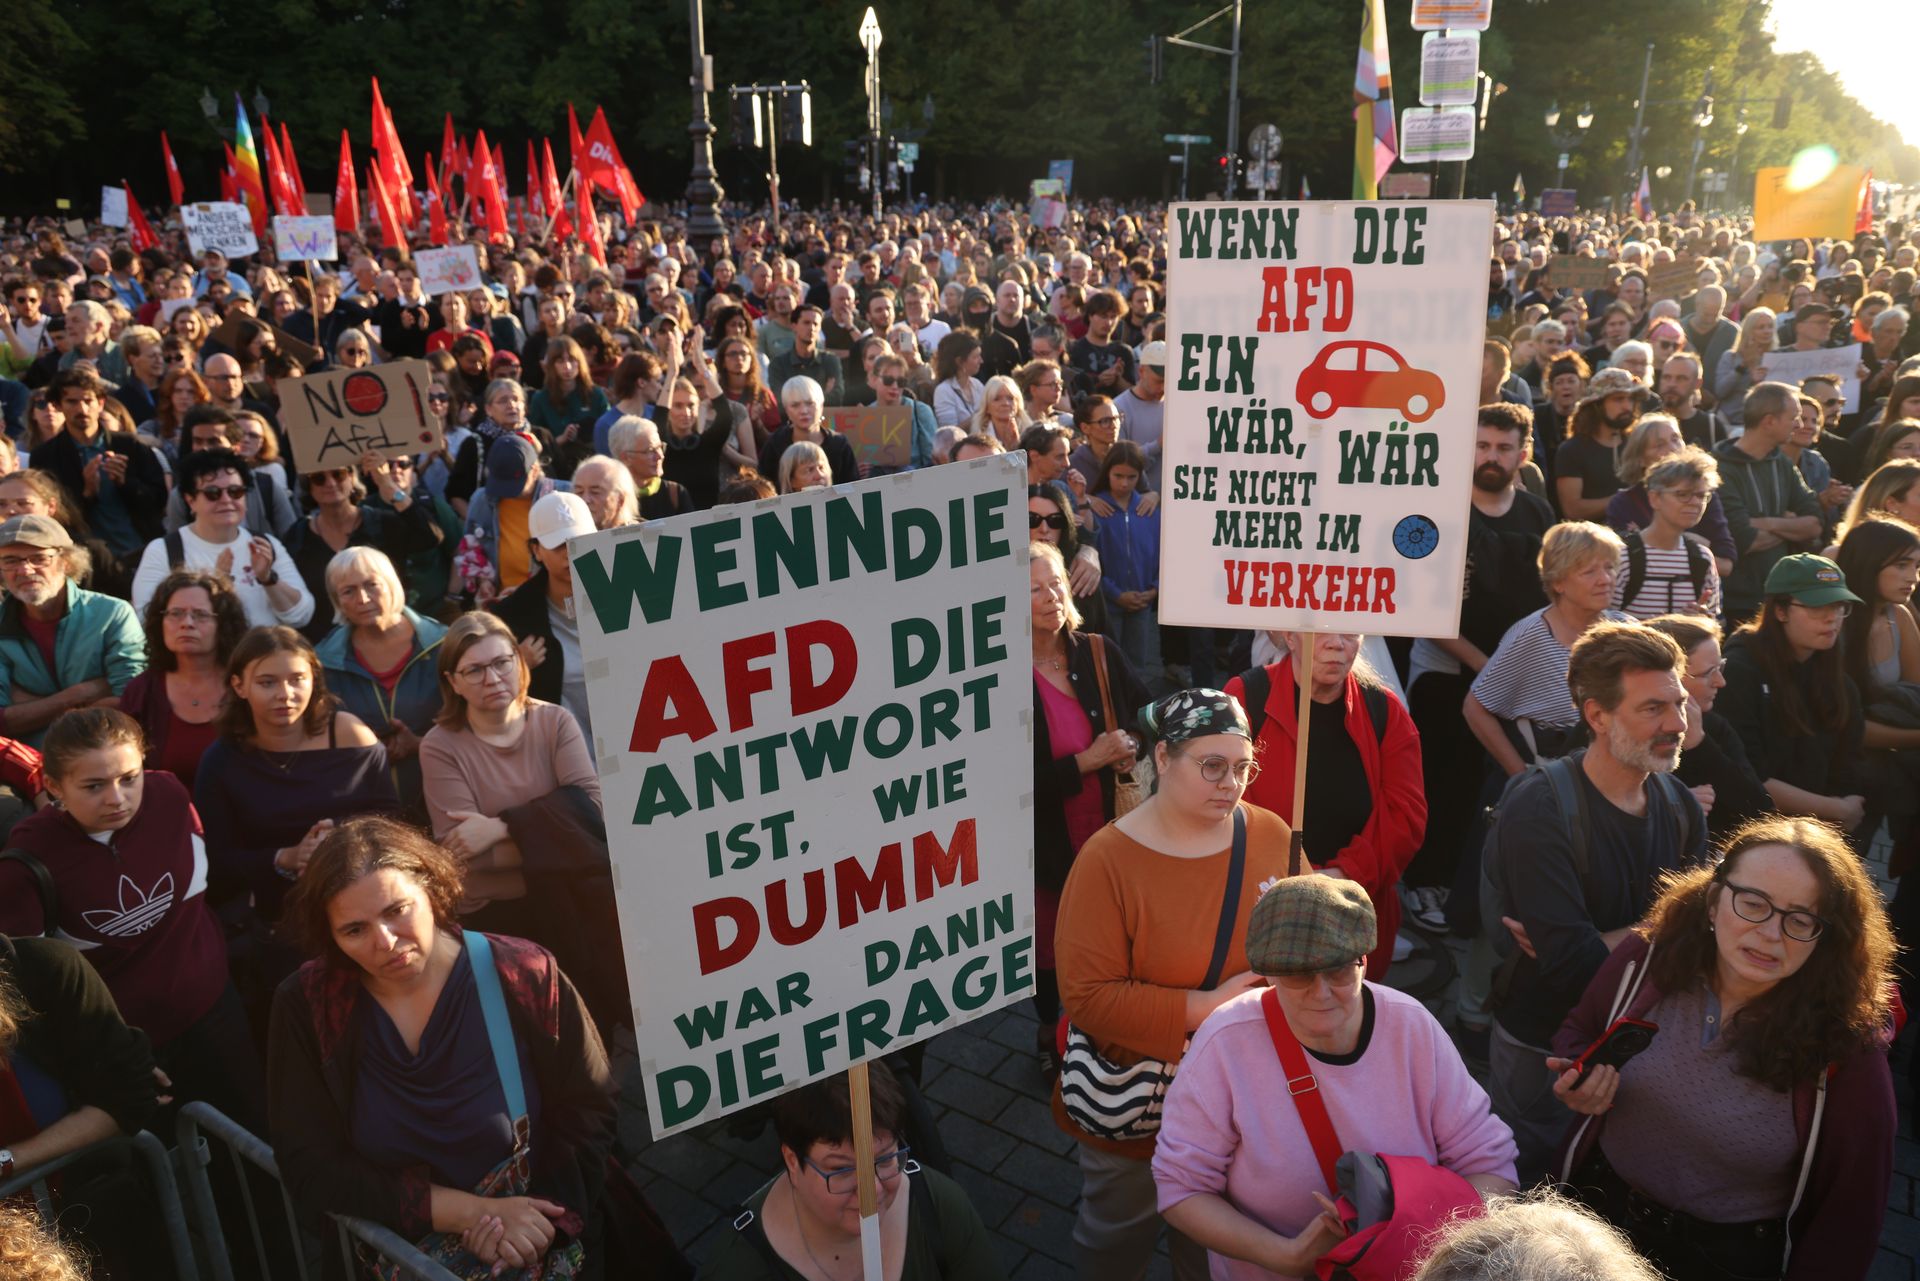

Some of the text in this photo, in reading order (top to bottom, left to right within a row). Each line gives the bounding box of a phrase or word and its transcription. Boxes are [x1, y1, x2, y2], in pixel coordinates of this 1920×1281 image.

[1177, 207, 1300, 260] WENN
[1352, 206, 1427, 265] DIE
[1256, 265, 1355, 333] AFD
[302, 371, 388, 424] NO
[1177, 333, 1259, 395] EIN
[1173, 464, 1317, 507] SIE NICHT
[1207, 398, 1440, 487] WÄR, WÄR
[573, 488, 1011, 635] WENN DIE
[1212, 510, 1303, 550] MEHR
[1316, 513, 1362, 554] IM
[1223, 559, 1397, 615] VERKEHR
[628, 595, 1008, 753] AFD DIE
[631, 673, 999, 825] ANTWORT
[705, 758, 967, 879] IST, WIE
[692, 817, 979, 976] DUMM
[673, 893, 1015, 1050] WAR DANN
[655, 935, 1034, 1130] DIE FRAGE
